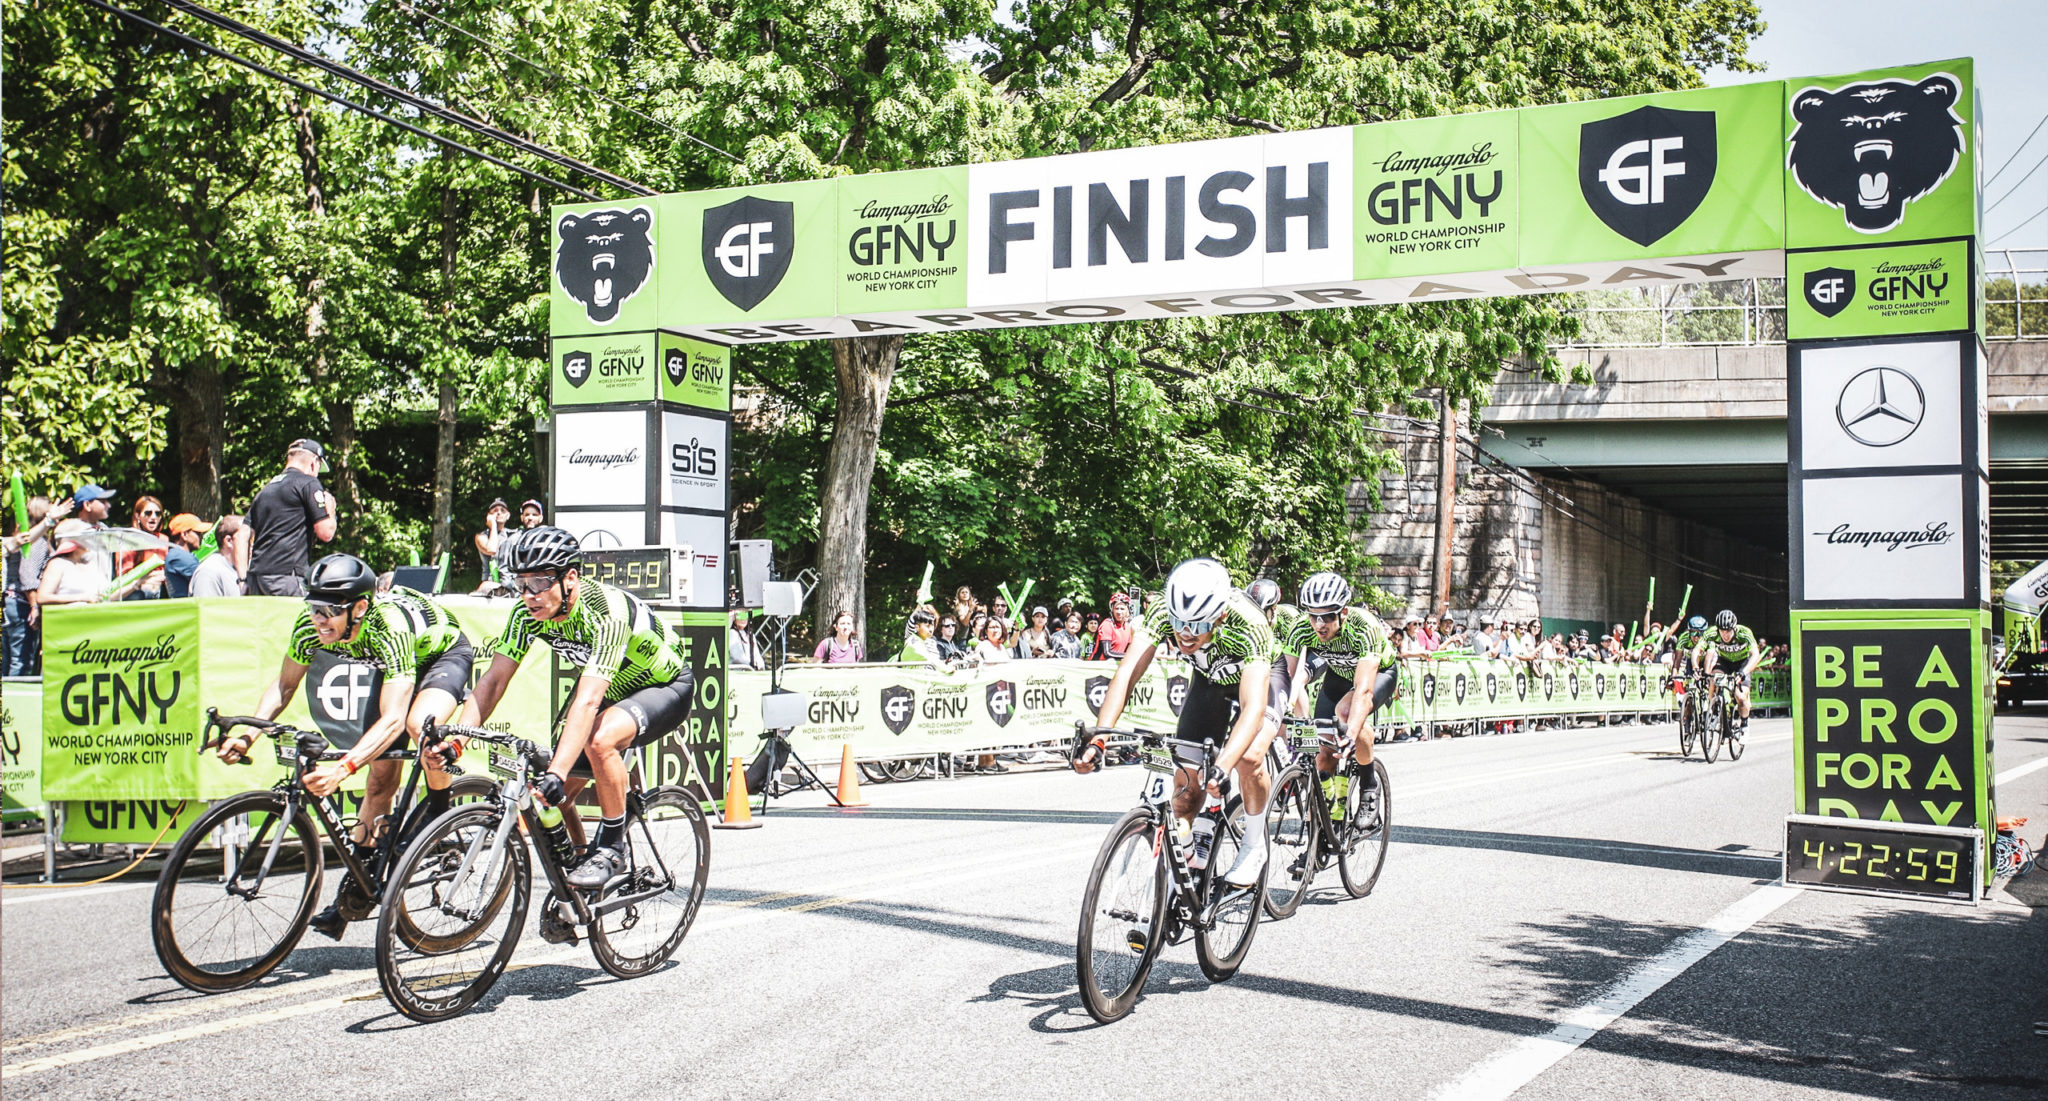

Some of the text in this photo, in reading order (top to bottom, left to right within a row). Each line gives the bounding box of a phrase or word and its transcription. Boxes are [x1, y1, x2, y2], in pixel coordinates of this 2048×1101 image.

[1372, 142, 1499, 176] Campagnolo
[1598, 136, 1686, 205] GF
[853, 194, 954, 223] Campagnolo
[1367, 170, 1502, 225] GFNY
[988, 161, 1329, 275] FINISH
[849, 219, 956, 266] GFNY
[1366, 223, 1506, 243] WORLD CHAMPIONSHIP
[1389, 238, 1481, 254] NEW YORK CITY
[714, 221, 774, 278] GF
[847, 266, 958, 282] WORLD CHAMPIONSHIP
[1871, 257, 1946, 275] Campagnolo
[706, 258, 1744, 340] BE A PRO FOR A DAY
[865, 279, 938, 292] NEW YORK CITY
[1811, 278, 1844, 304] GF
[1868, 272, 1948, 301] GFNY
[1894, 300, 1950, 309] CHAMPIONSHIP
[599, 356, 644, 376] GFNY
[601, 345, 641, 358] Campagnolo
[691, 362, 723, 385] GFNY
[561, 447, 640, 470] Campagnolo
[1812, 521, 1955, 552] Campagnolo
[58, 633, 182, 673] Campagnolo
[704, 637, 721, 669] A
[1815, 645, 1883, 688] BE
[1915, 645, 1960, 688] A
[60, 670, 181, 726] GFNY
[316, 663, 371, 720] GF
[1023, 688, 1067, 710] GFNY
[808, 700, 859, 724] GFNY
[922, 696, 968, 719] GFNY
[1816, 698, 1958, 744] PRO
[48, 733, 193, 749] WORLD CHAMPIONSHIP
[706, 716, 721, 744] A
[74, 751, 168, 766] NEW YORK CITY
[663, 750, 720, 787] DAY
[1816, 752, 1963, 791] FOR A
[1803, 839, 1958, 884] 4:22:59
